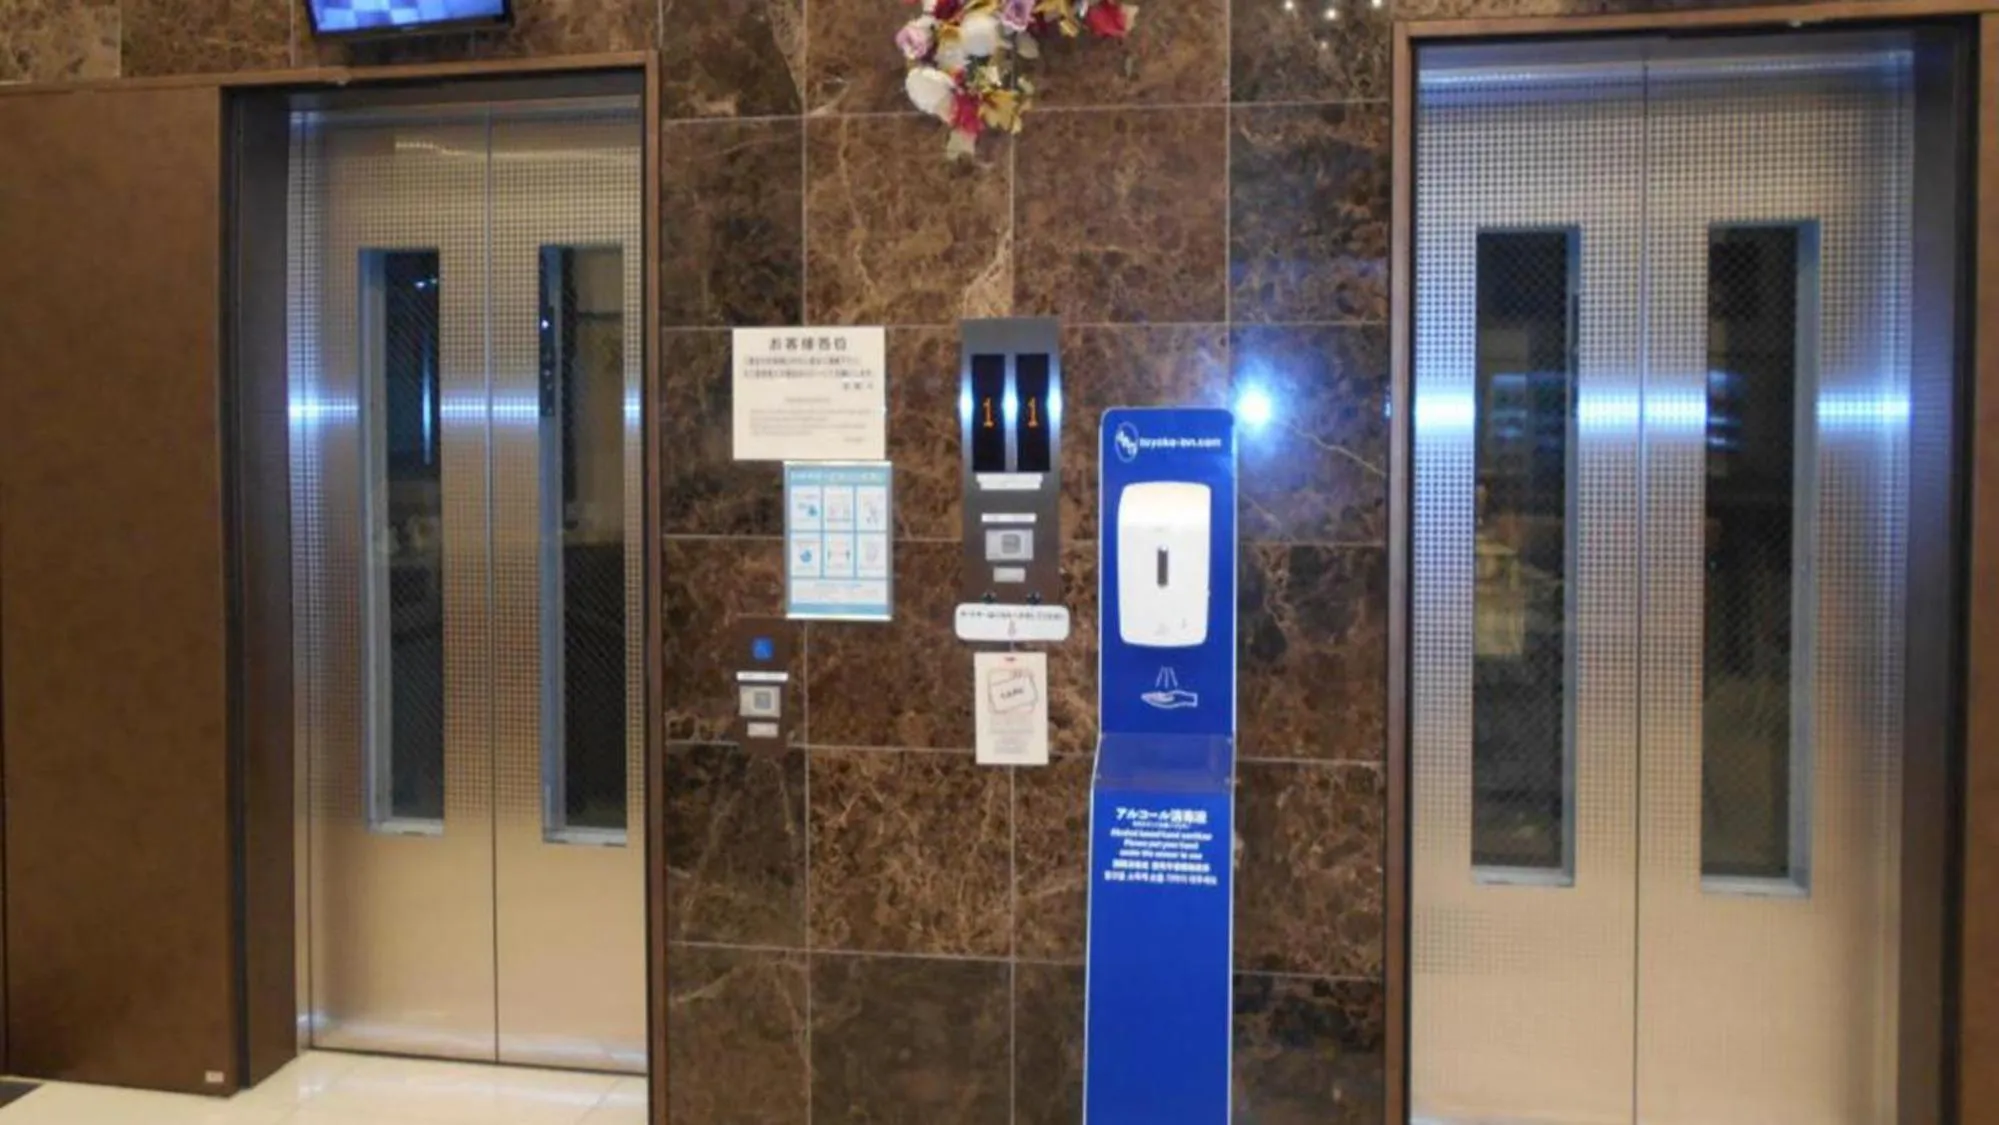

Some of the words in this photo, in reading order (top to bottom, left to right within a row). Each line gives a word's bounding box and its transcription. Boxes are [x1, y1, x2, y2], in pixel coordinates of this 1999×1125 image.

[983, 397, 994, 428] 1
[1028, 397, 1039, 428] 1
[1116, 807, 1208, 824] アルコール消毒液
